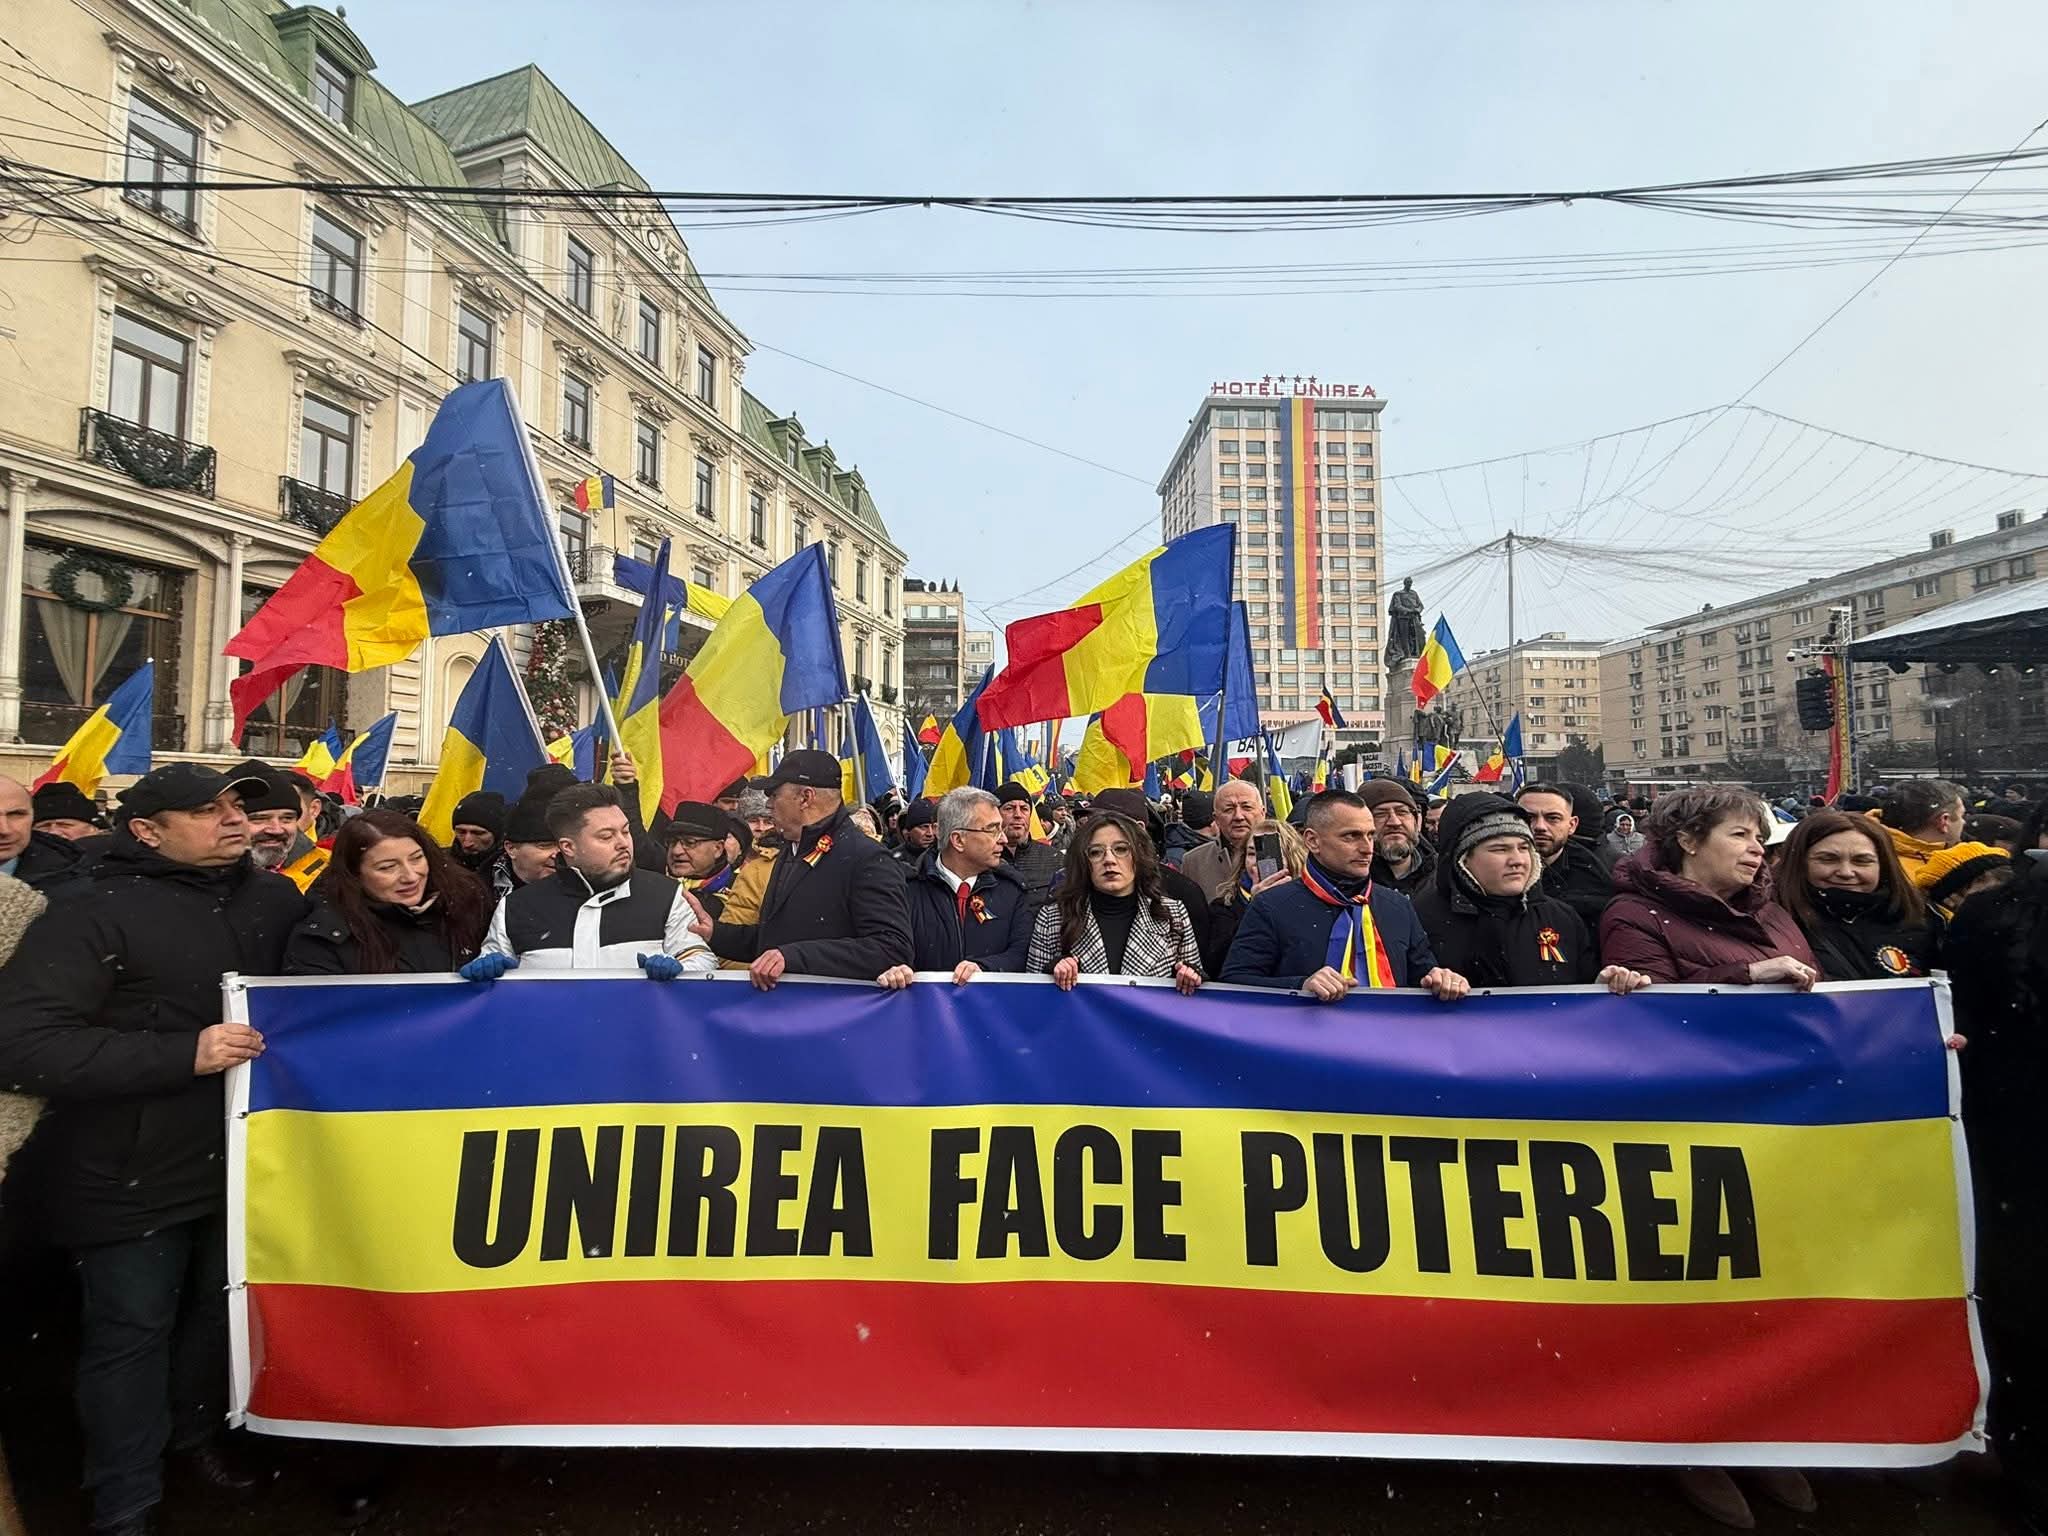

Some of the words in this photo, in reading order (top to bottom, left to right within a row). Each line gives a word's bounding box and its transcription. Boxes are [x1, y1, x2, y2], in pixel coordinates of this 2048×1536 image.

[1213, 382, 1285, 396] HOTEL
[1294, 384, 1377, 398] UNIREA
[1237, 731, 1286, 753] BAU
[452, 1124, 874, 1269] UNIREA
[928, 1125, 1187, 1262] FACE
[1240, 1131, 1762, 1281] PUTEREA
